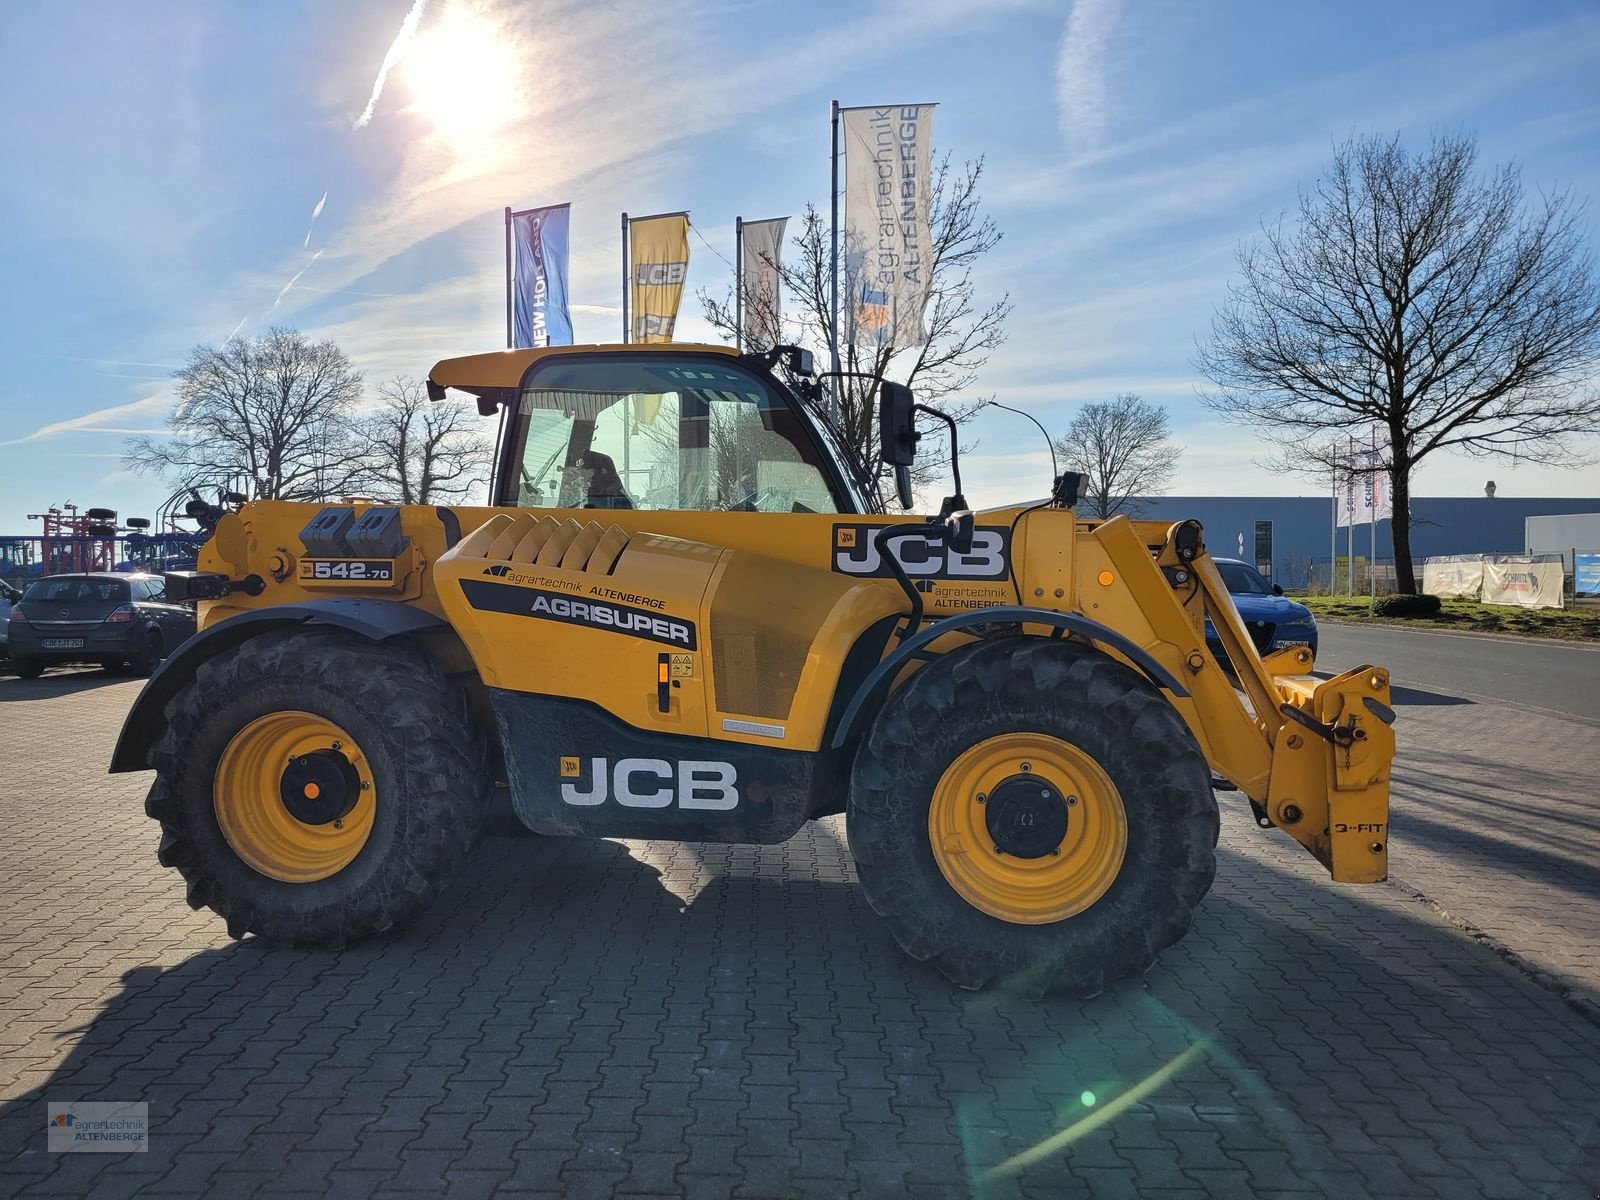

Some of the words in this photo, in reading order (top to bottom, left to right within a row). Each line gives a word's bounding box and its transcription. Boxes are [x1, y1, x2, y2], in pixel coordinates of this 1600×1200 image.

[869, 108, 899, 284] agrartechnik
[900, 106, 921, 284] ALTENBERGE
[315, 562, 389, 579] 542-70
[837, 528, 1004, 575] JCB
[508, 572, 583, 592] agrartechnik
[589, 586, 667, 610] ALTENBERGE
[934, 599, 1007, 609] ALTENBERGE
[935, 587, 1007, 598] agrartechnik
[531, 596, 689, 643] AGRISUPER
[560, 757, 739, 811] JCB
